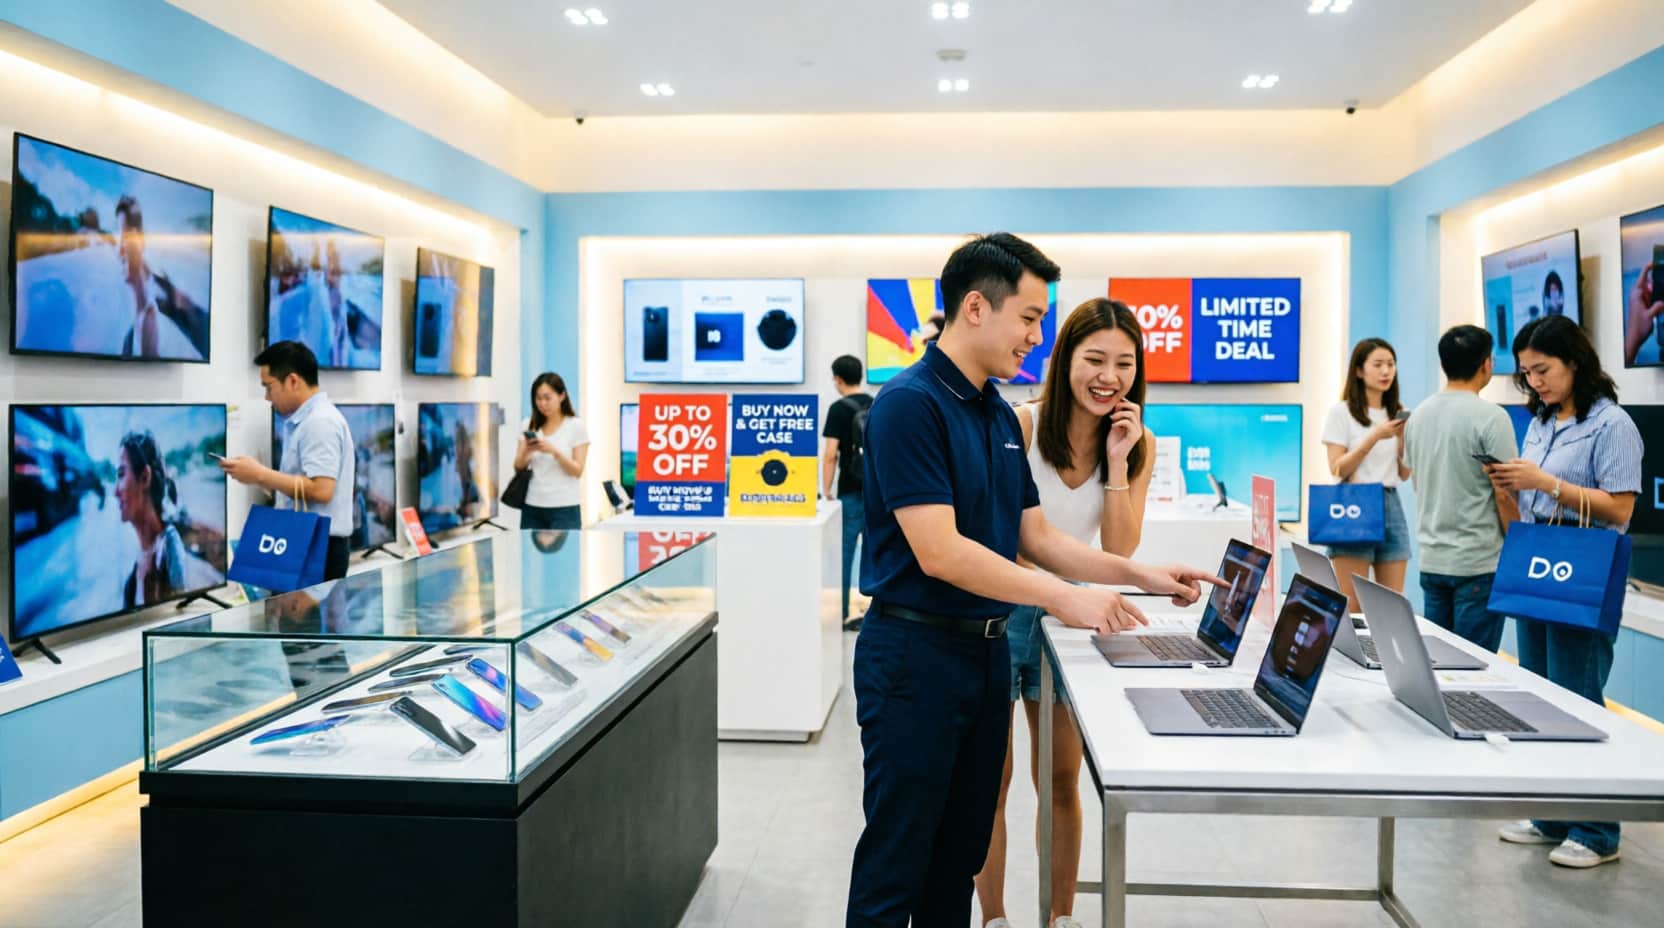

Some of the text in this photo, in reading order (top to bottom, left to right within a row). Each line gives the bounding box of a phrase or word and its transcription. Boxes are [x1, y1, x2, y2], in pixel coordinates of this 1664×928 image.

[1200, 297, 1291, 317] LIMITED
[1217, 319, 1273, 338] TIME
[1142, 331, 1183, 353] FF
[1215, 341, 1275, 360] DEAL
[654, 405, 712, 421] UP TO
[741, 404, 809, 417] BUY NOW
[735, 418, 814, 431] & GET FREE
[648, 424, 717, 451] 30%
[756, 432, 793, 444] CASE
[652, 453, 709, 476] OFF
[1527, 556, 1573, 582] DO
